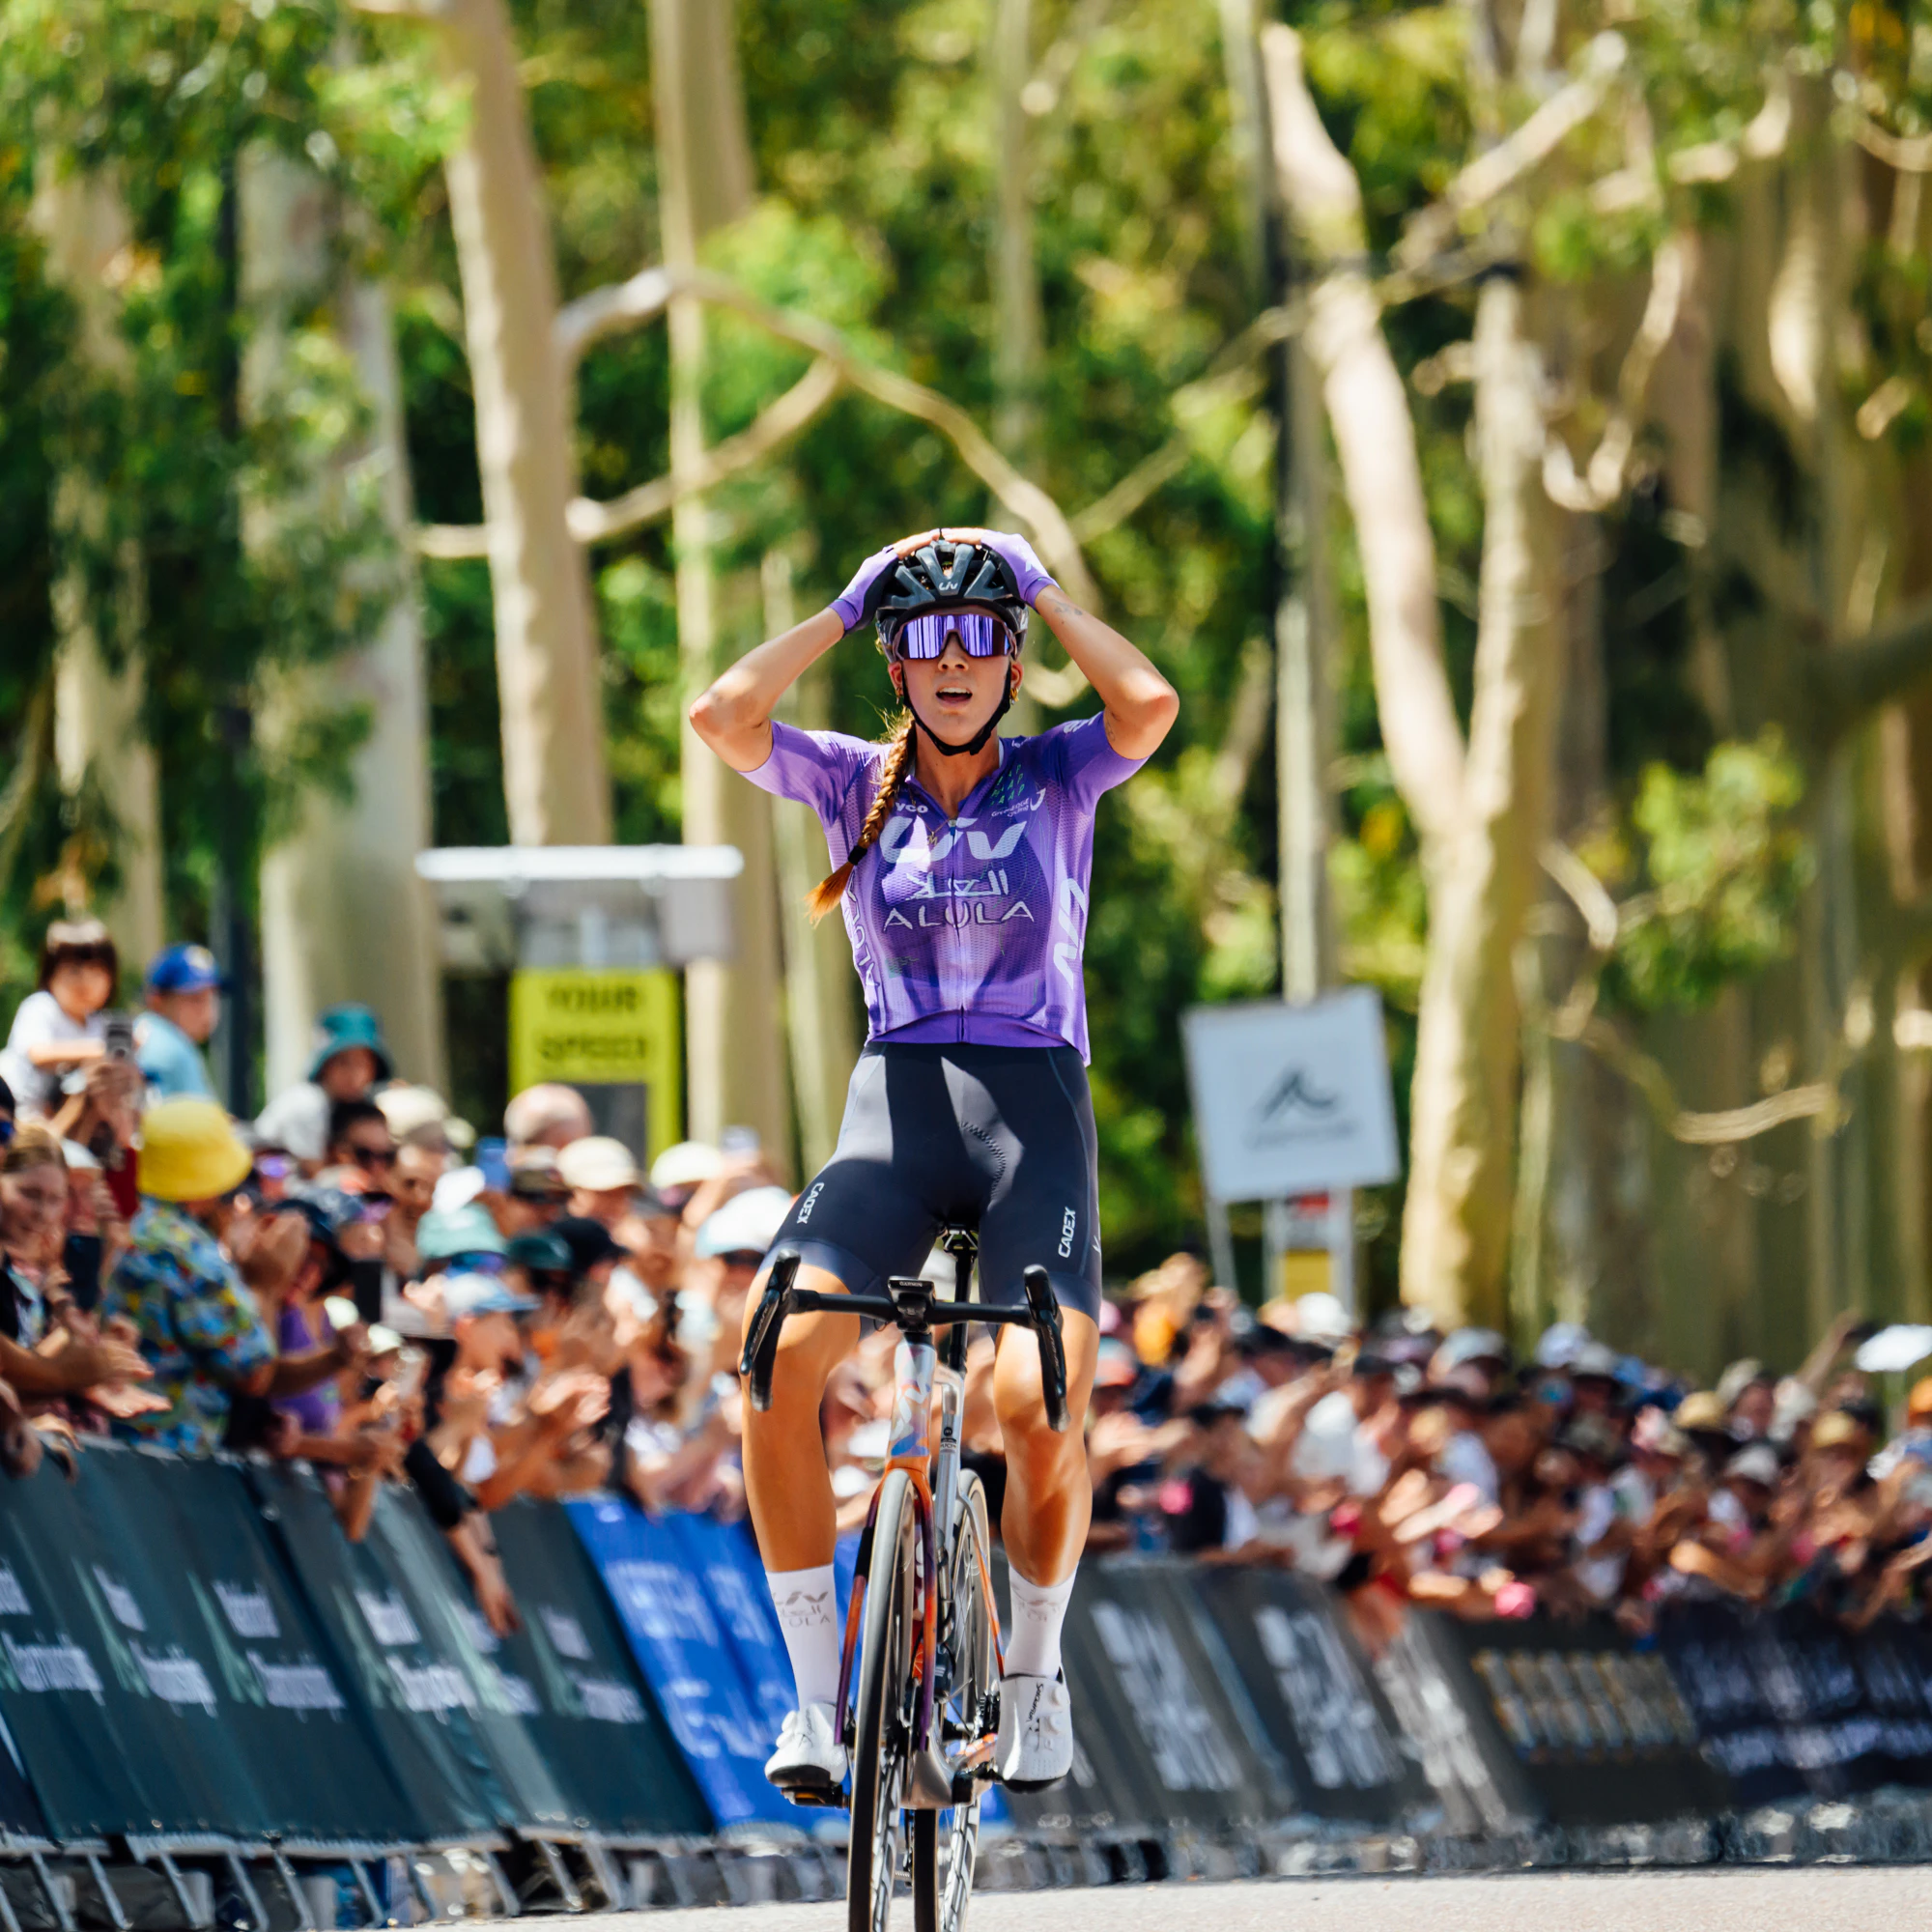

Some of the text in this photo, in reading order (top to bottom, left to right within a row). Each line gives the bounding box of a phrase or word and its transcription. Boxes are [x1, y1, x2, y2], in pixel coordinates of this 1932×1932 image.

[895, 802, 929, 814] yco
[883, 900, 1035, 932] ALULA
[796, 1181, 825, 1224] CADEX
[1058, 1206, 1076, 1258] CADEX
